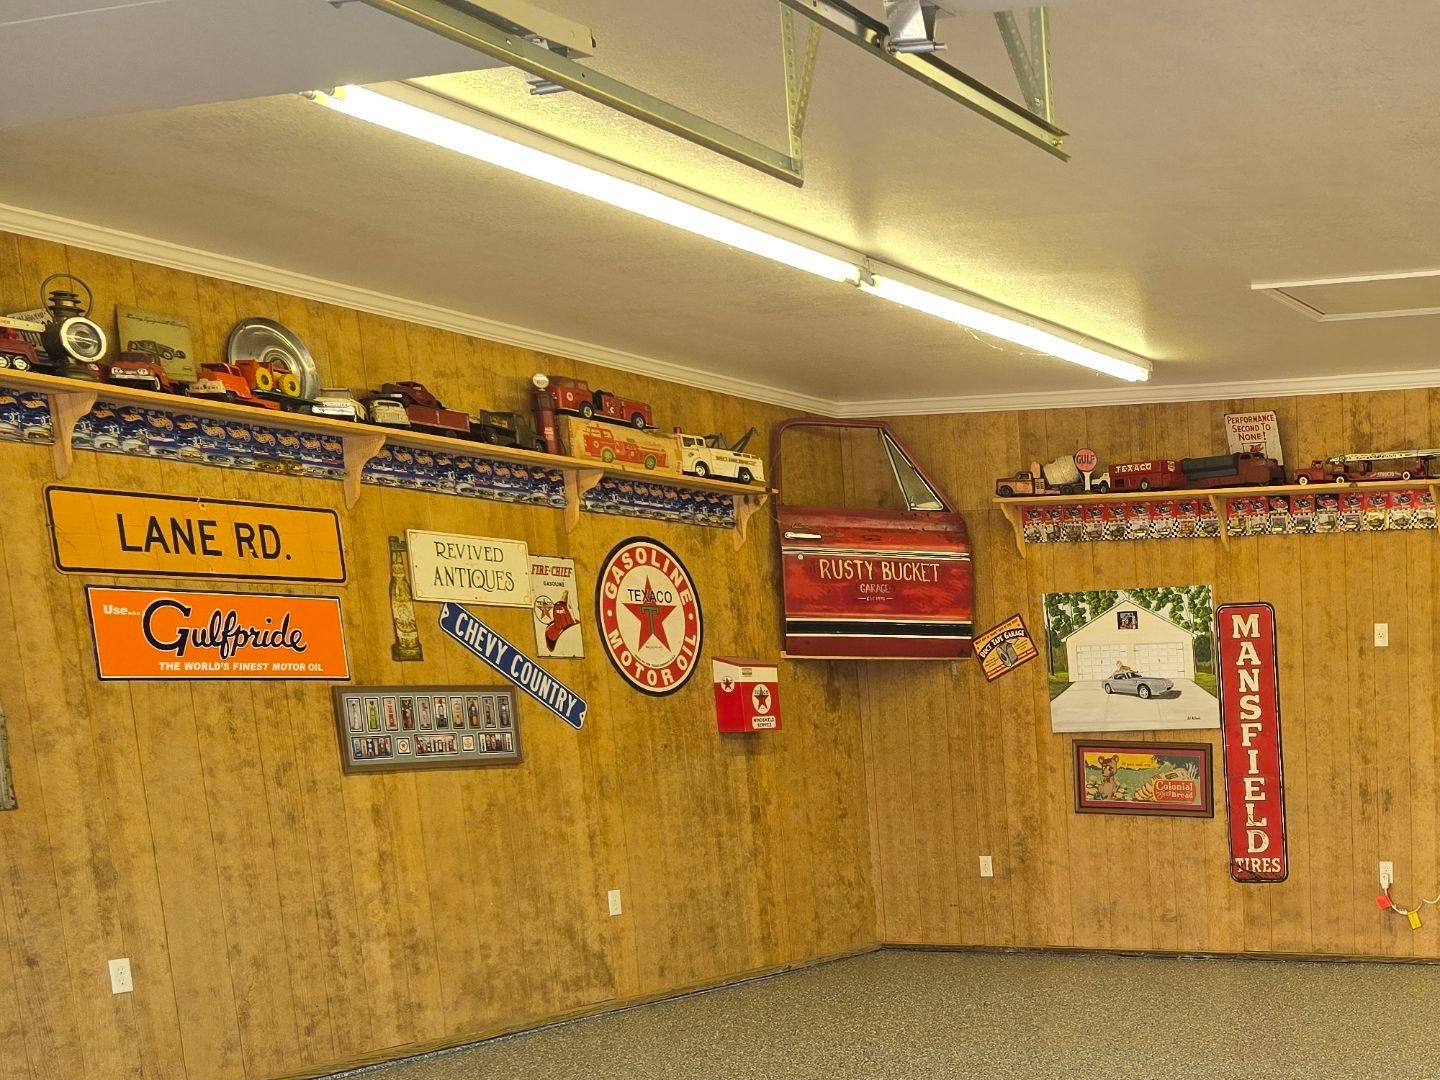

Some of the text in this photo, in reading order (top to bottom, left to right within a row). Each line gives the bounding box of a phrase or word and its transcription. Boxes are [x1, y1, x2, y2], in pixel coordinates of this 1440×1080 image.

[1227, 414, 1275, 424] PERFORMANCE
[1232, 422, 1271, 433] SECOND TO
[1076, 454, 1096, 464] GULF
[1115, 463, 1152, 473] TEXACO
[116, 513, 292, 561] LANE RD.
[434, 541, 504, 563] REVIVED
[531, 564, 573, 578] FIRE-CHIEF
[605, 547, 693, 607] GASOLINE
[820, 559, 940, 582] RUSTY BUCKET
[433, 566, 515, 592] ANTIQUES
[860, 583, 891, 593] GARAGE
[627, 589, 673, 604] TEXACO
[103, 604, 141, 616] Use...
[143, 598, 307, 660] Gulfpride
[608, 628, 697, 686] MOTOR OIL
[980, 644, 992, 658] DUCT
[159, 661, 323, 672] THE WORLD'S FINEST MOTOR OIL
[455, 612, 578, 718] CHEVY COUNTRY
[1231, 613, 1270, 854] MANSFIELD
[1156, 781, 1193, 791] Colonial
[1235, 857, 1281, 873] TIRES
